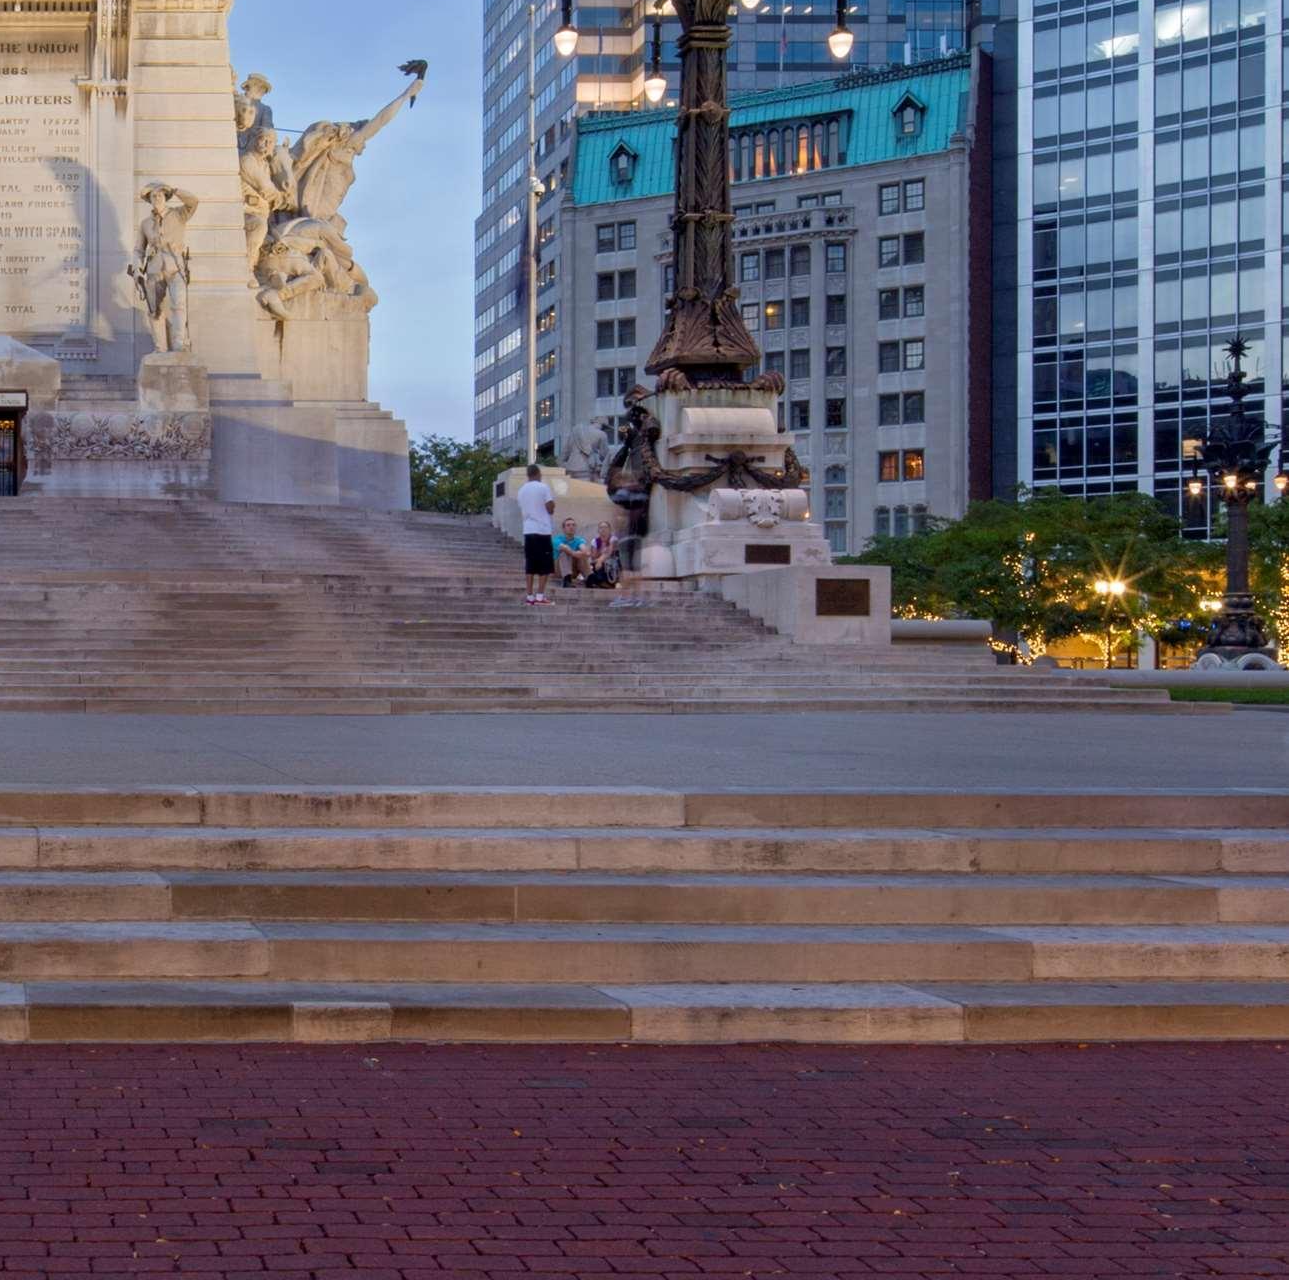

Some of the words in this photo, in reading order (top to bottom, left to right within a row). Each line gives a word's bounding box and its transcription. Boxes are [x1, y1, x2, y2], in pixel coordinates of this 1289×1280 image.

[27, 43, 79, 54] UNION
[14, 226, 43, 238] WITH
[46, 226, 81, 238] SPAIN.
[5, 255, 46, 263] INFANTRY
[5, 305, 35, 313] TOTAL
